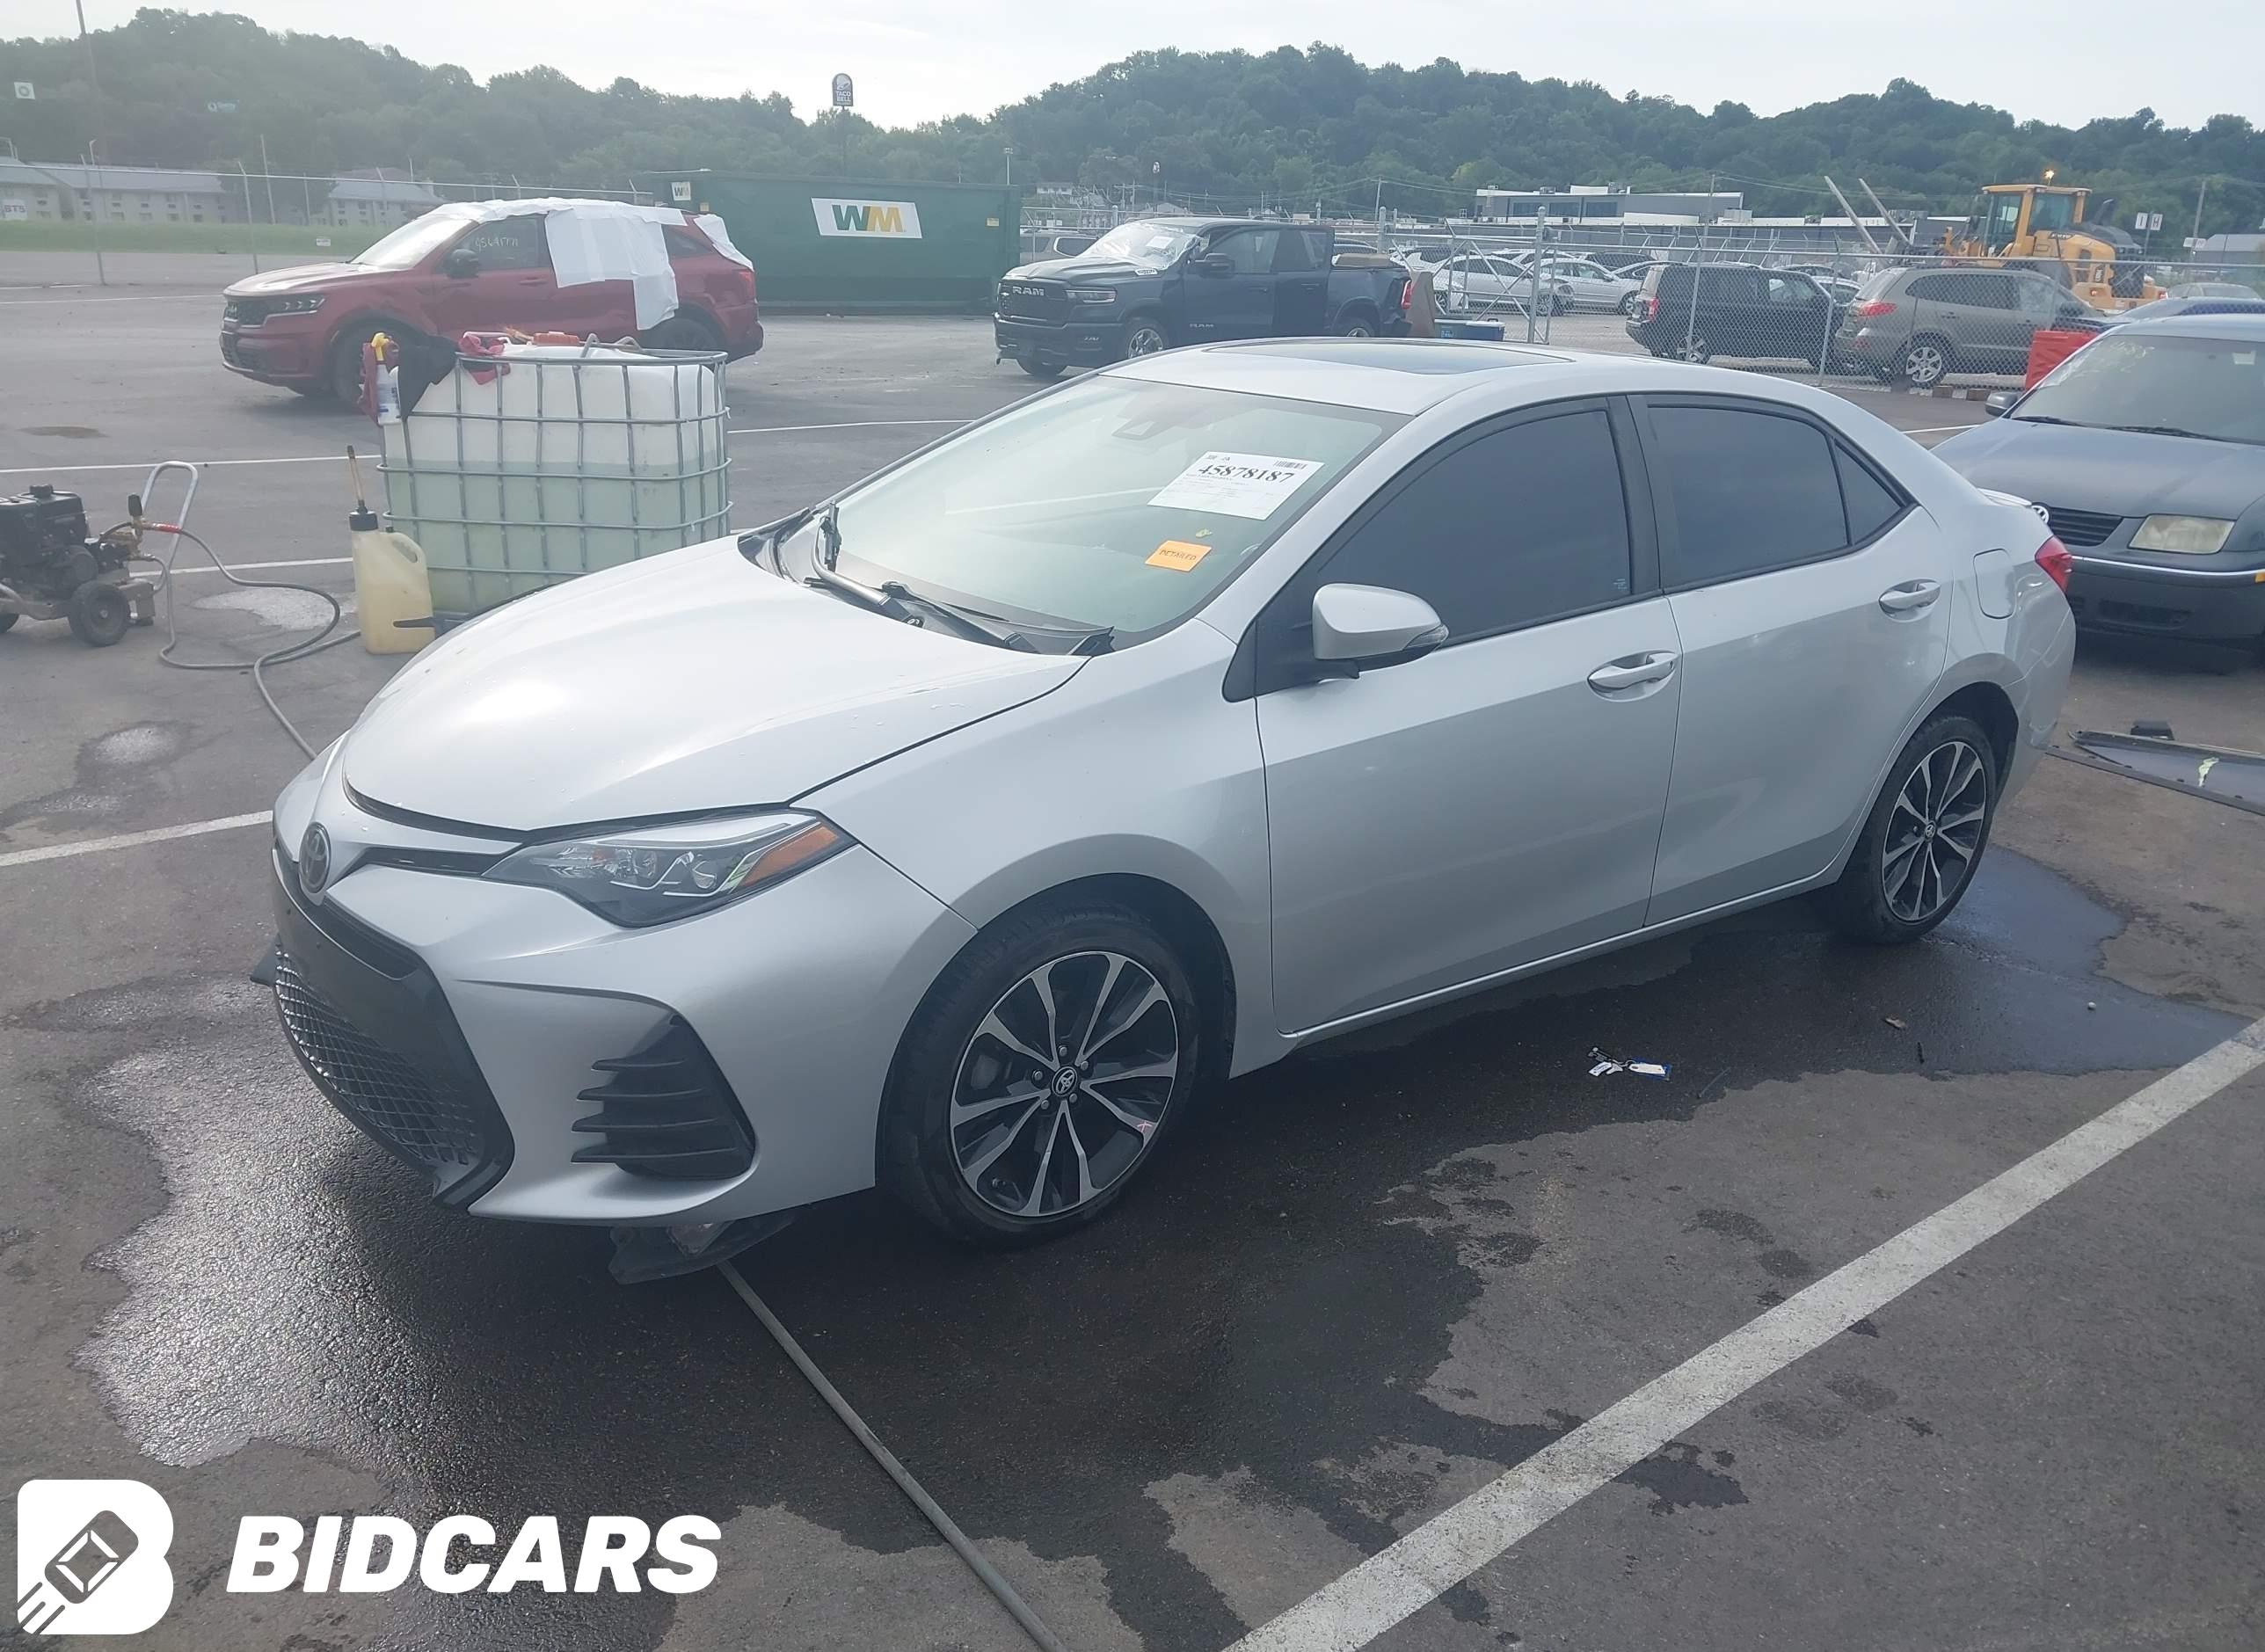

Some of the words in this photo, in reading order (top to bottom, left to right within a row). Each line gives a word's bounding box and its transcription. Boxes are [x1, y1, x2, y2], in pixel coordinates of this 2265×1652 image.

[832, 204, 903, 232] WM
[1012, 286, 1045, 296] RAM
[1198, 464, 1294, 483] 45878187
